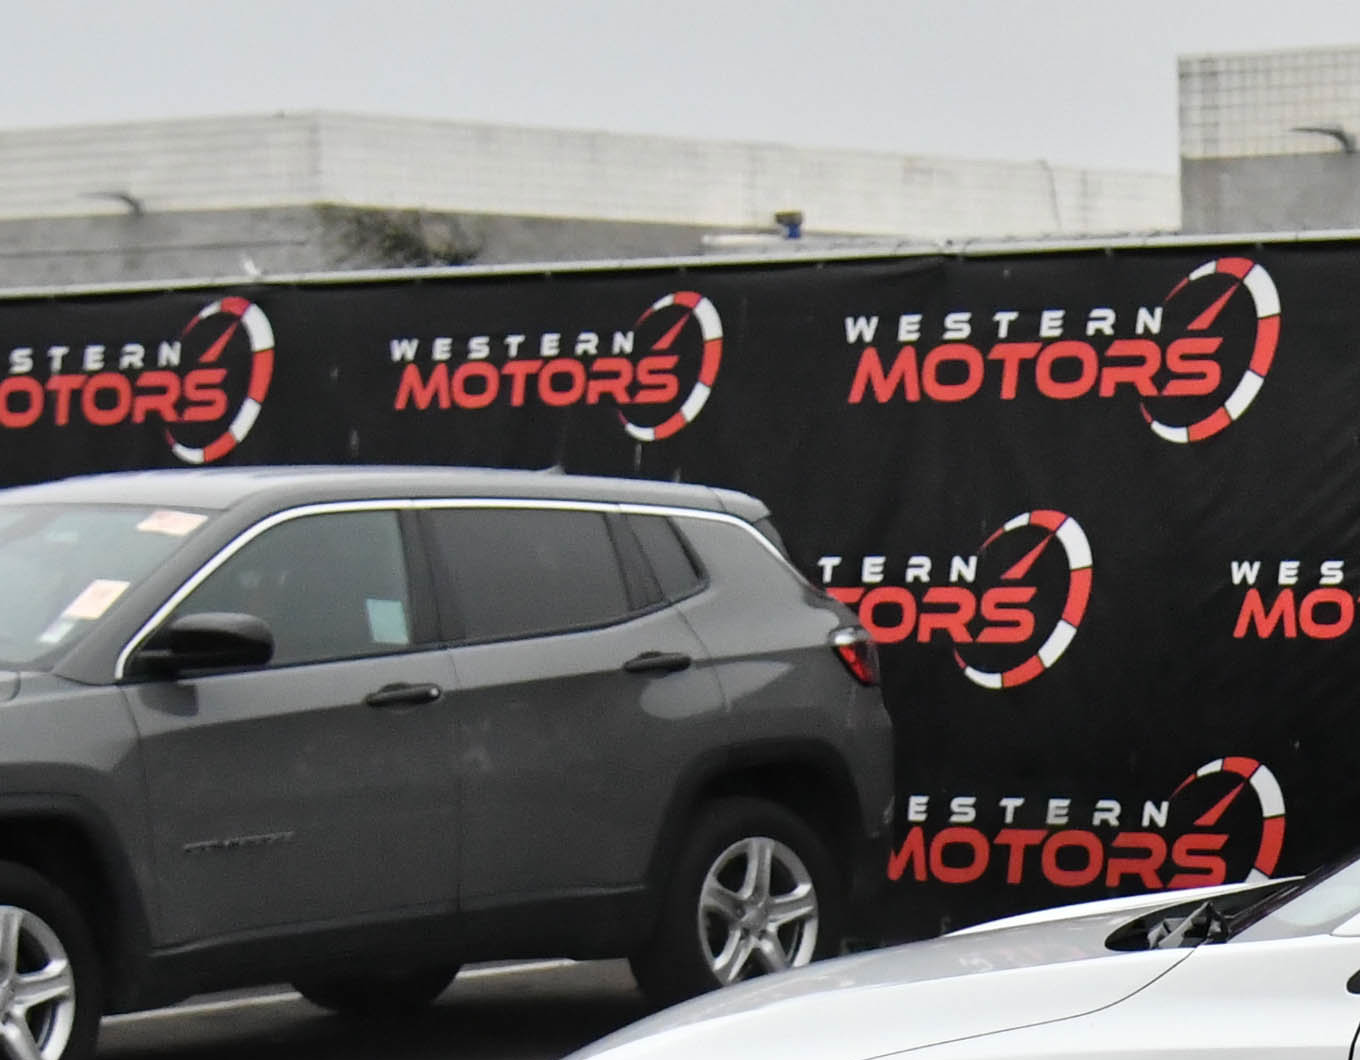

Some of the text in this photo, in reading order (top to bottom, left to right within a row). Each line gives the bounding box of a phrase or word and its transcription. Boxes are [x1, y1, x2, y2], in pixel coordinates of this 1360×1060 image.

[845, 307, 1163, 343] WESTERN
[9, 341, 182, 374] STERN
[389, 331, 635, 361] WESTERN
[394, 355, 680, 410] MOTORS
[848, 337, 1224, 404] MOTORS
[0, 368, 228, 428] OTORS
[817, 555, 978, 583] TERN
[907, 796, 1169, 828] ESTERN
